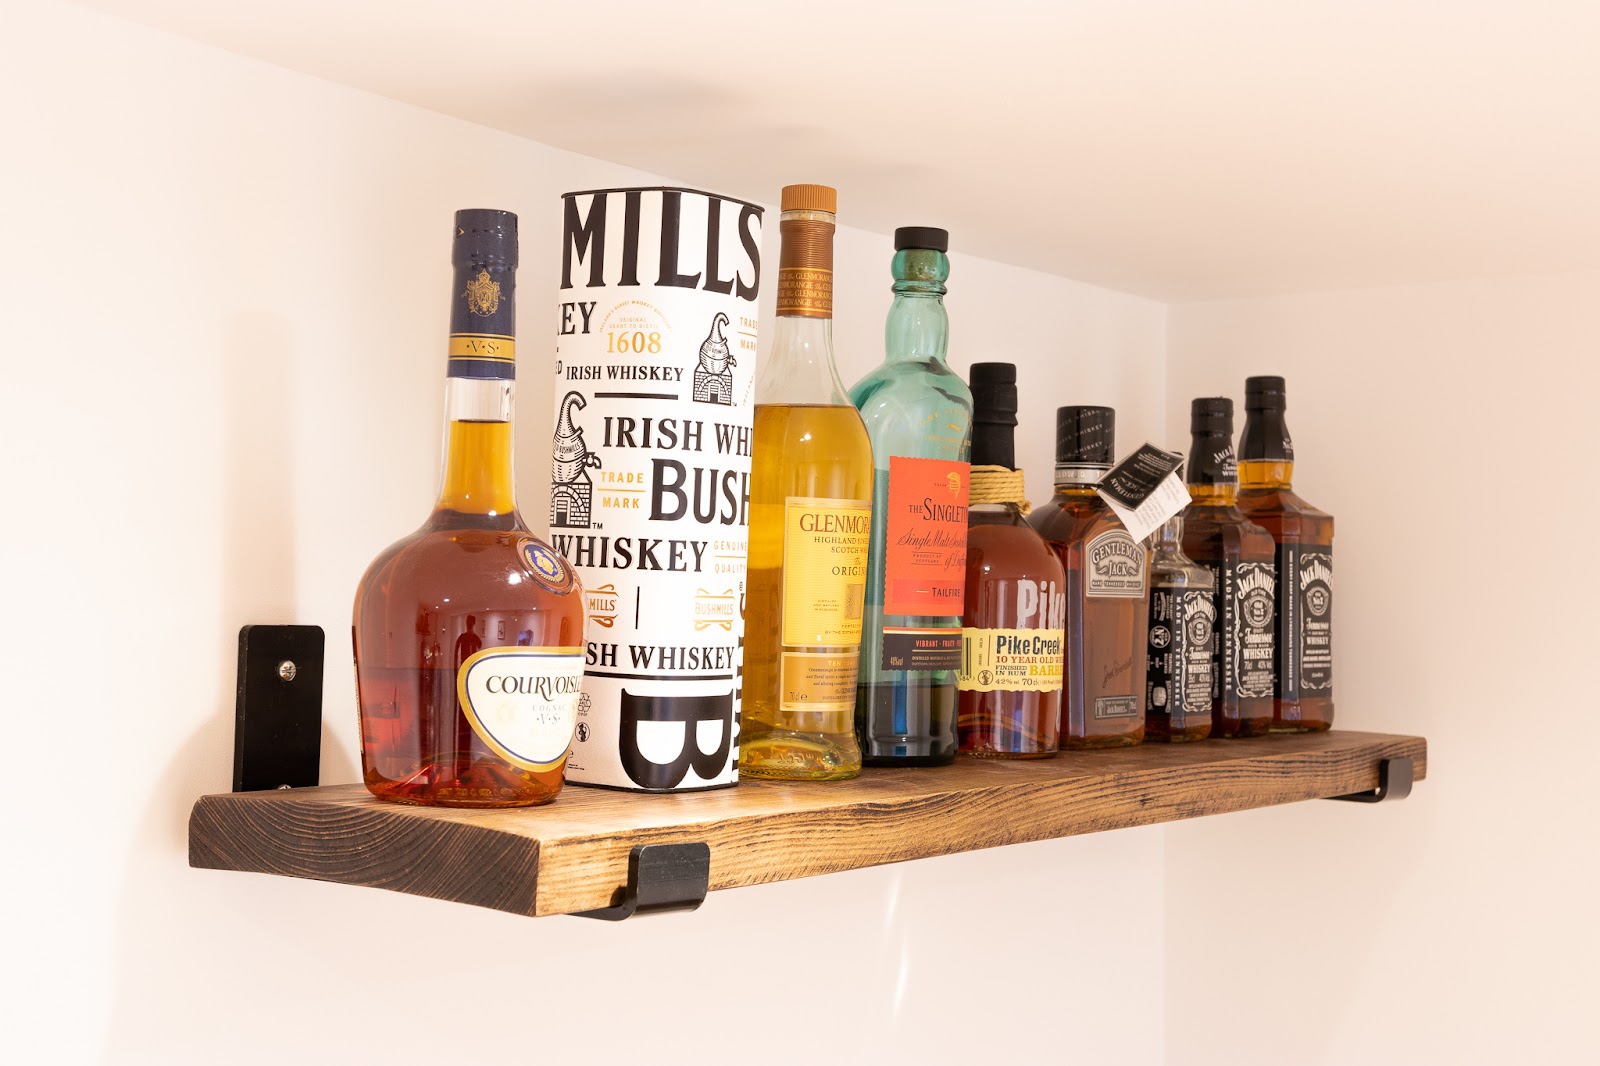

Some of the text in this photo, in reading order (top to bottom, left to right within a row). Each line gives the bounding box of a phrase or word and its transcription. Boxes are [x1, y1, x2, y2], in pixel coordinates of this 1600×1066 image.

[560, 191, 762, 301] MILLS
[557, 301, 597, 335] EY
[606, 331, 662, 354] 1608
[566, 365, 602, 380] IRISH
[606, 365, 684, 382] WHISKEY
[602, 416, 704, 452] IRISH
[601, 471, 644, 484] TRADE
[1110, 477, 1145, 499] GENTLEMAN
[602, 497, 640, 509] MARK
[908, 504, 923, 514] THE
[713, 540, 747, 552] GENUINE
[813, 536, 857, 545] HIGHLAND
[896, 527, 931, 552] Single
[551, 534, 708, 573] WHISKEY
[830, 546, 859, 554] SCOTCH
[1091, 542, 1141, 565] GENTLEMAN
[1108, 560, 1127, 578] JACK
[932, 587, 961, 598] TAILFIRE
[694, 601, 734, 616] BUSHMILLS
[1016, 580, 1066, 630] Pike
[1225, 606, 1232, 619] IN
[1175, 630, 1181, 642] IN
[1306, 636, 1329, 645] WHISKEY
[915, 639, 938, 648] VIBRANT
[996, 634, 1031, 655] Pike
[628, 644, 736, 670] WHISKEY
[996, 656, 1008, 664] 10
[1011, 656, 1038, 664] YEAR
[1242, 647, 1274, 660] WHISKEY
[1187, 663, 1211, 674] WHISKEY
